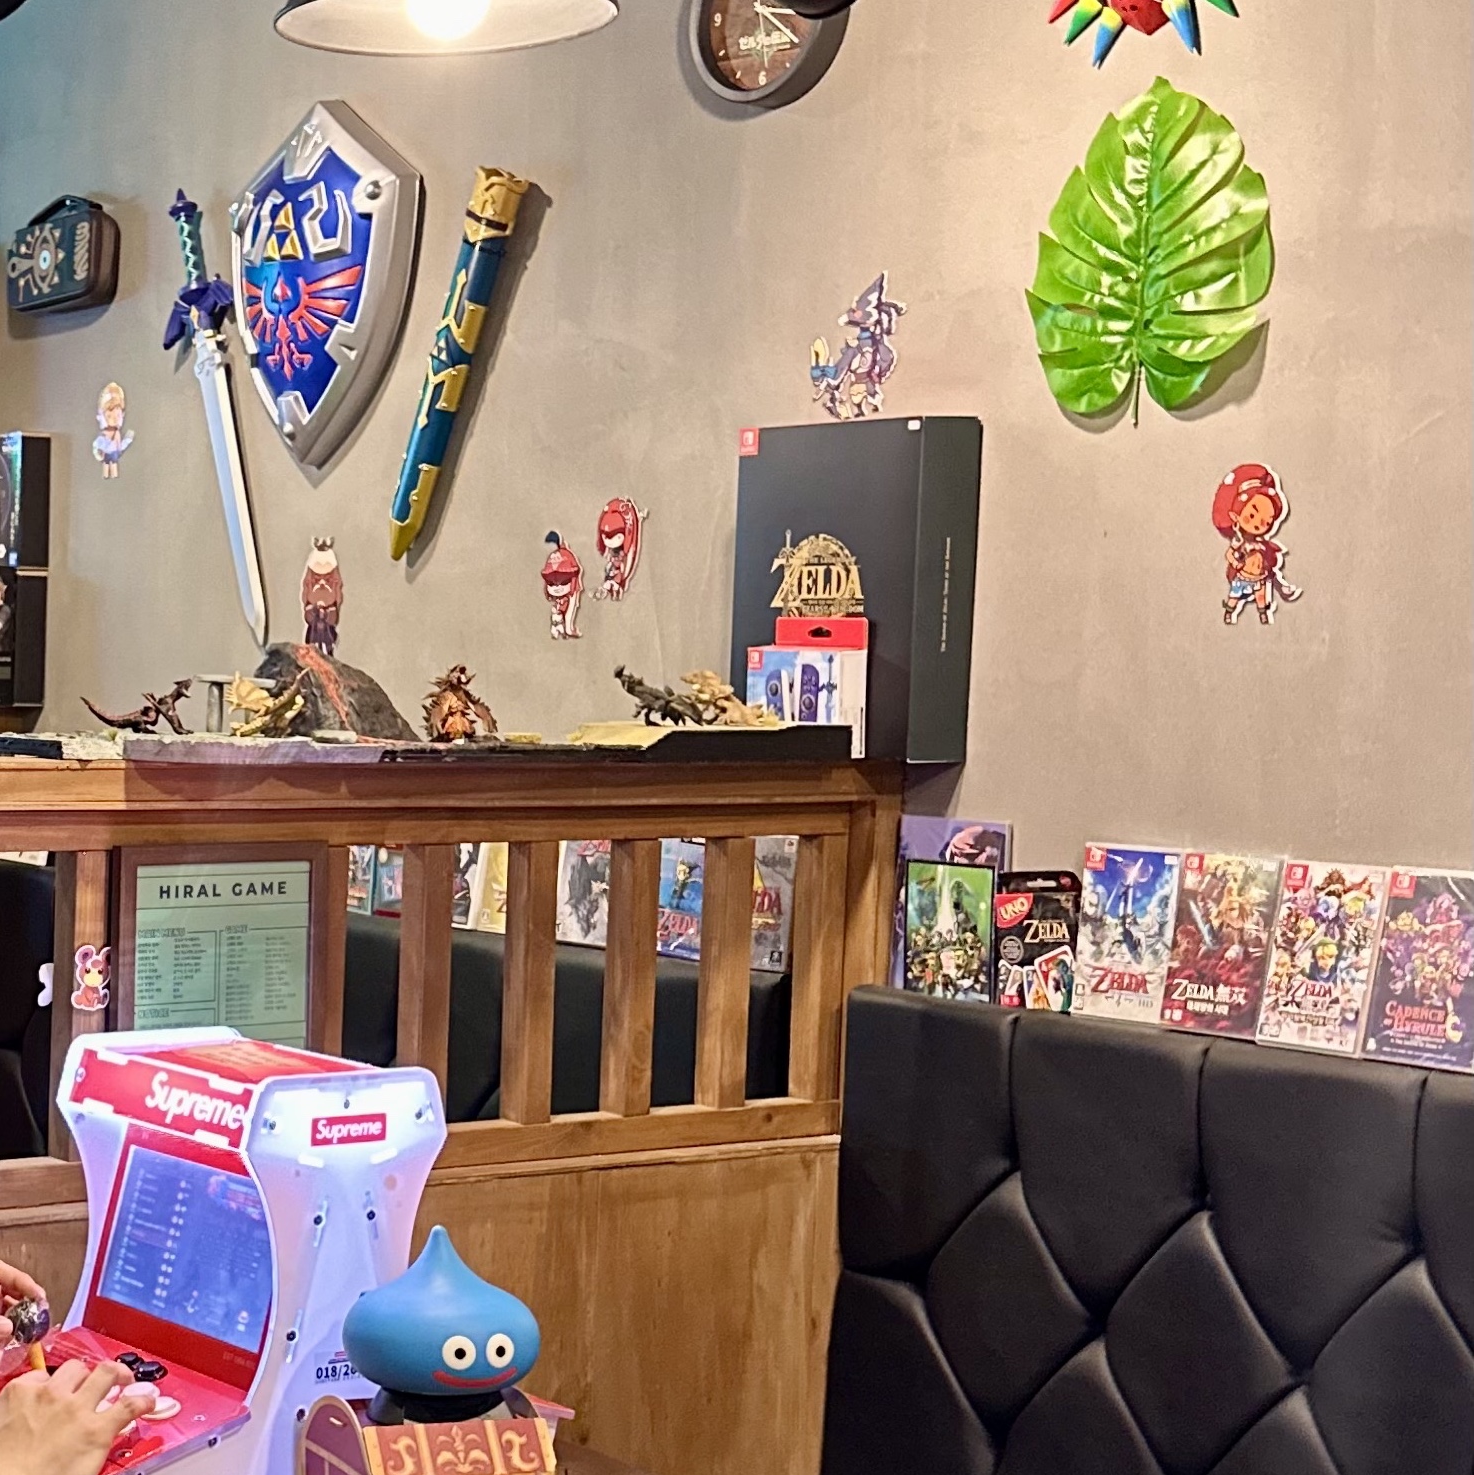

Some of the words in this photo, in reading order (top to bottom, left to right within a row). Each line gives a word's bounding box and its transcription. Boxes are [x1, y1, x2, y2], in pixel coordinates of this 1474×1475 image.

[714, 13, 722, 27] 9
[758, 71, 766, 85] 6
[770, 558, 864, 607] ZELDA
[159, 883, 222, 899] HIRAL
[232, 881, 288, 897] GAME
[999, 896, 1029, 921] UNO
[1023, 920, 1071, 943] ZELDA
[1087, 966, 1150, 995] ZELDA
[1171, 979, 1214, 1001] ZELDA
[1385, 1000, 1446, 1023] CADENCE
[145, 1071, 246, 1130] Supreme
[315, 1119, 383, 1145] Supreme
